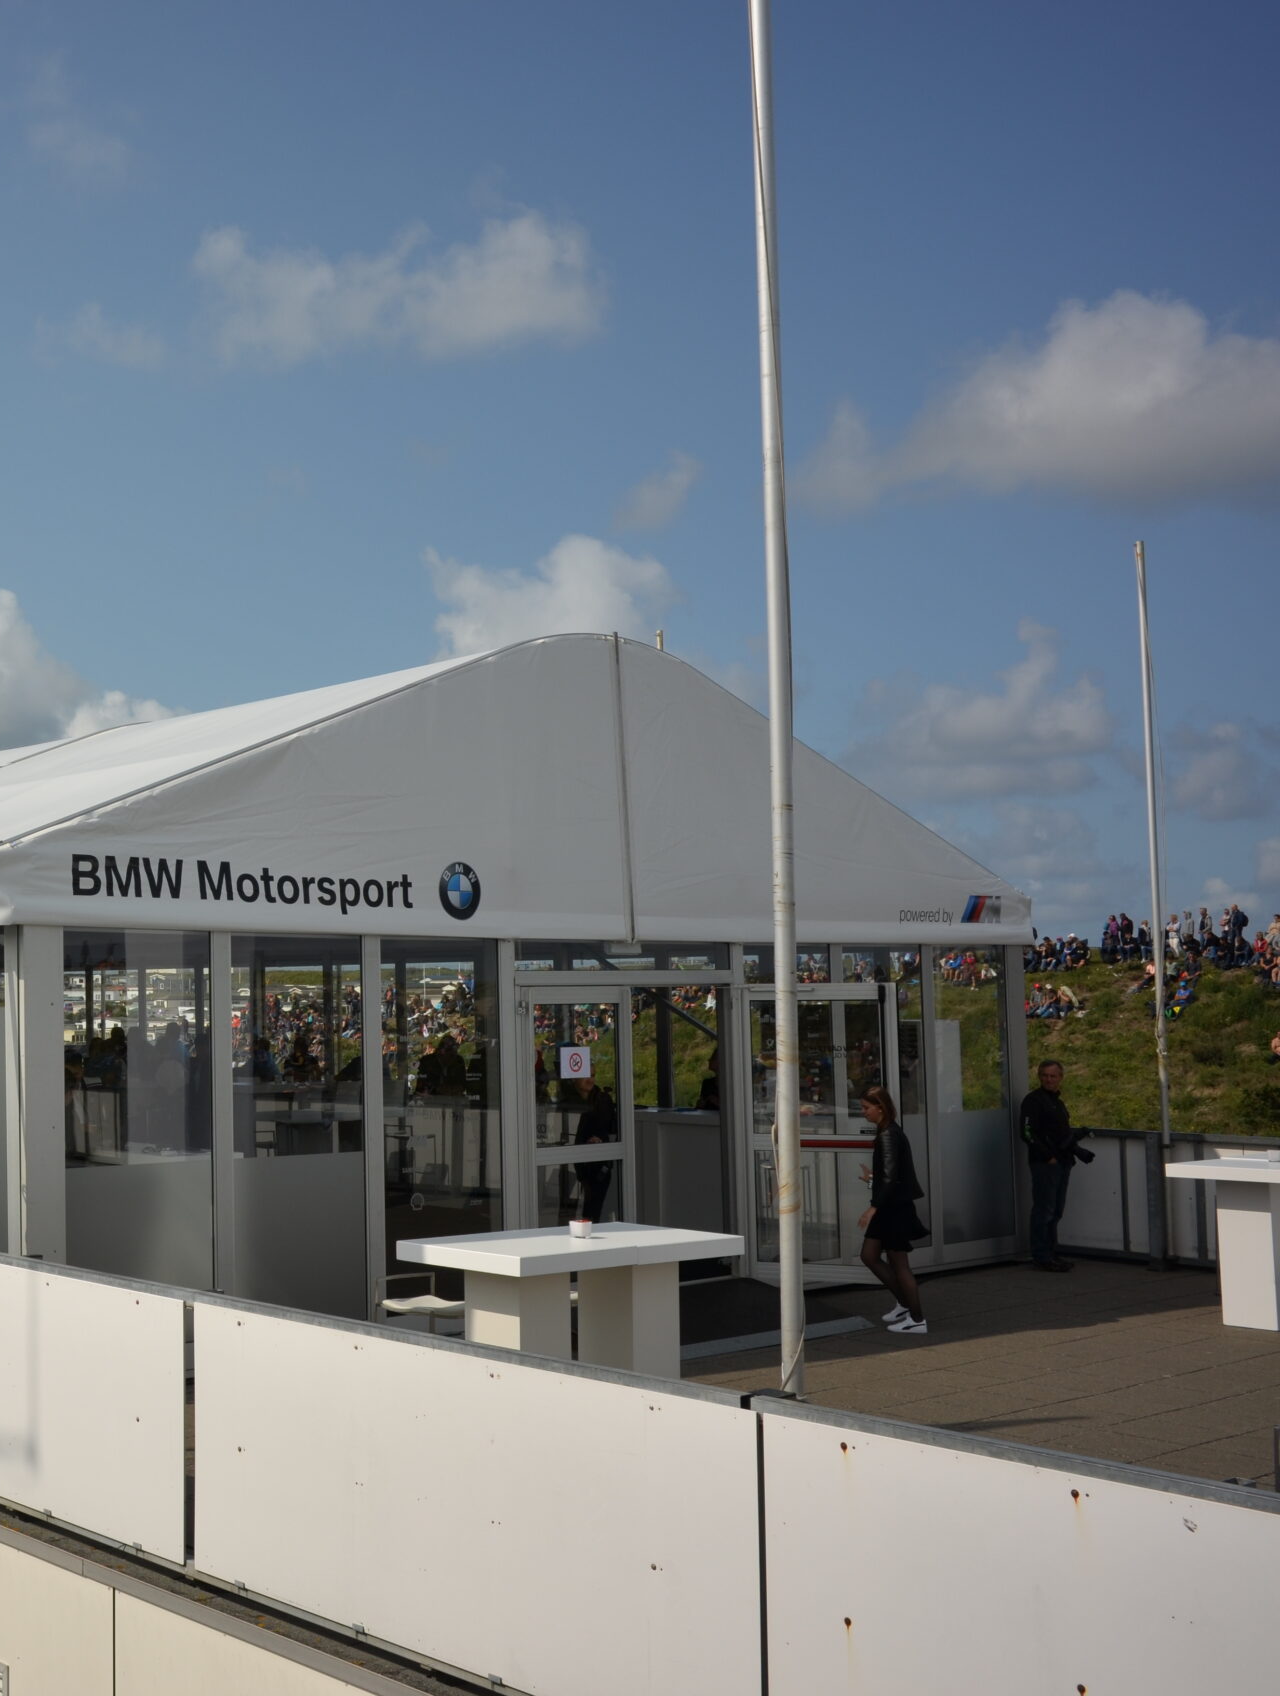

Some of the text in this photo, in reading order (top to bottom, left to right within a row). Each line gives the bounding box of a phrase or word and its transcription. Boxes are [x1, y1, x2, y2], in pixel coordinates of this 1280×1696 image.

[72, 854, 413, 915] BMW Motorsport
[899, 907, 941, 925] powered
[942, 907, 954, 926] by
